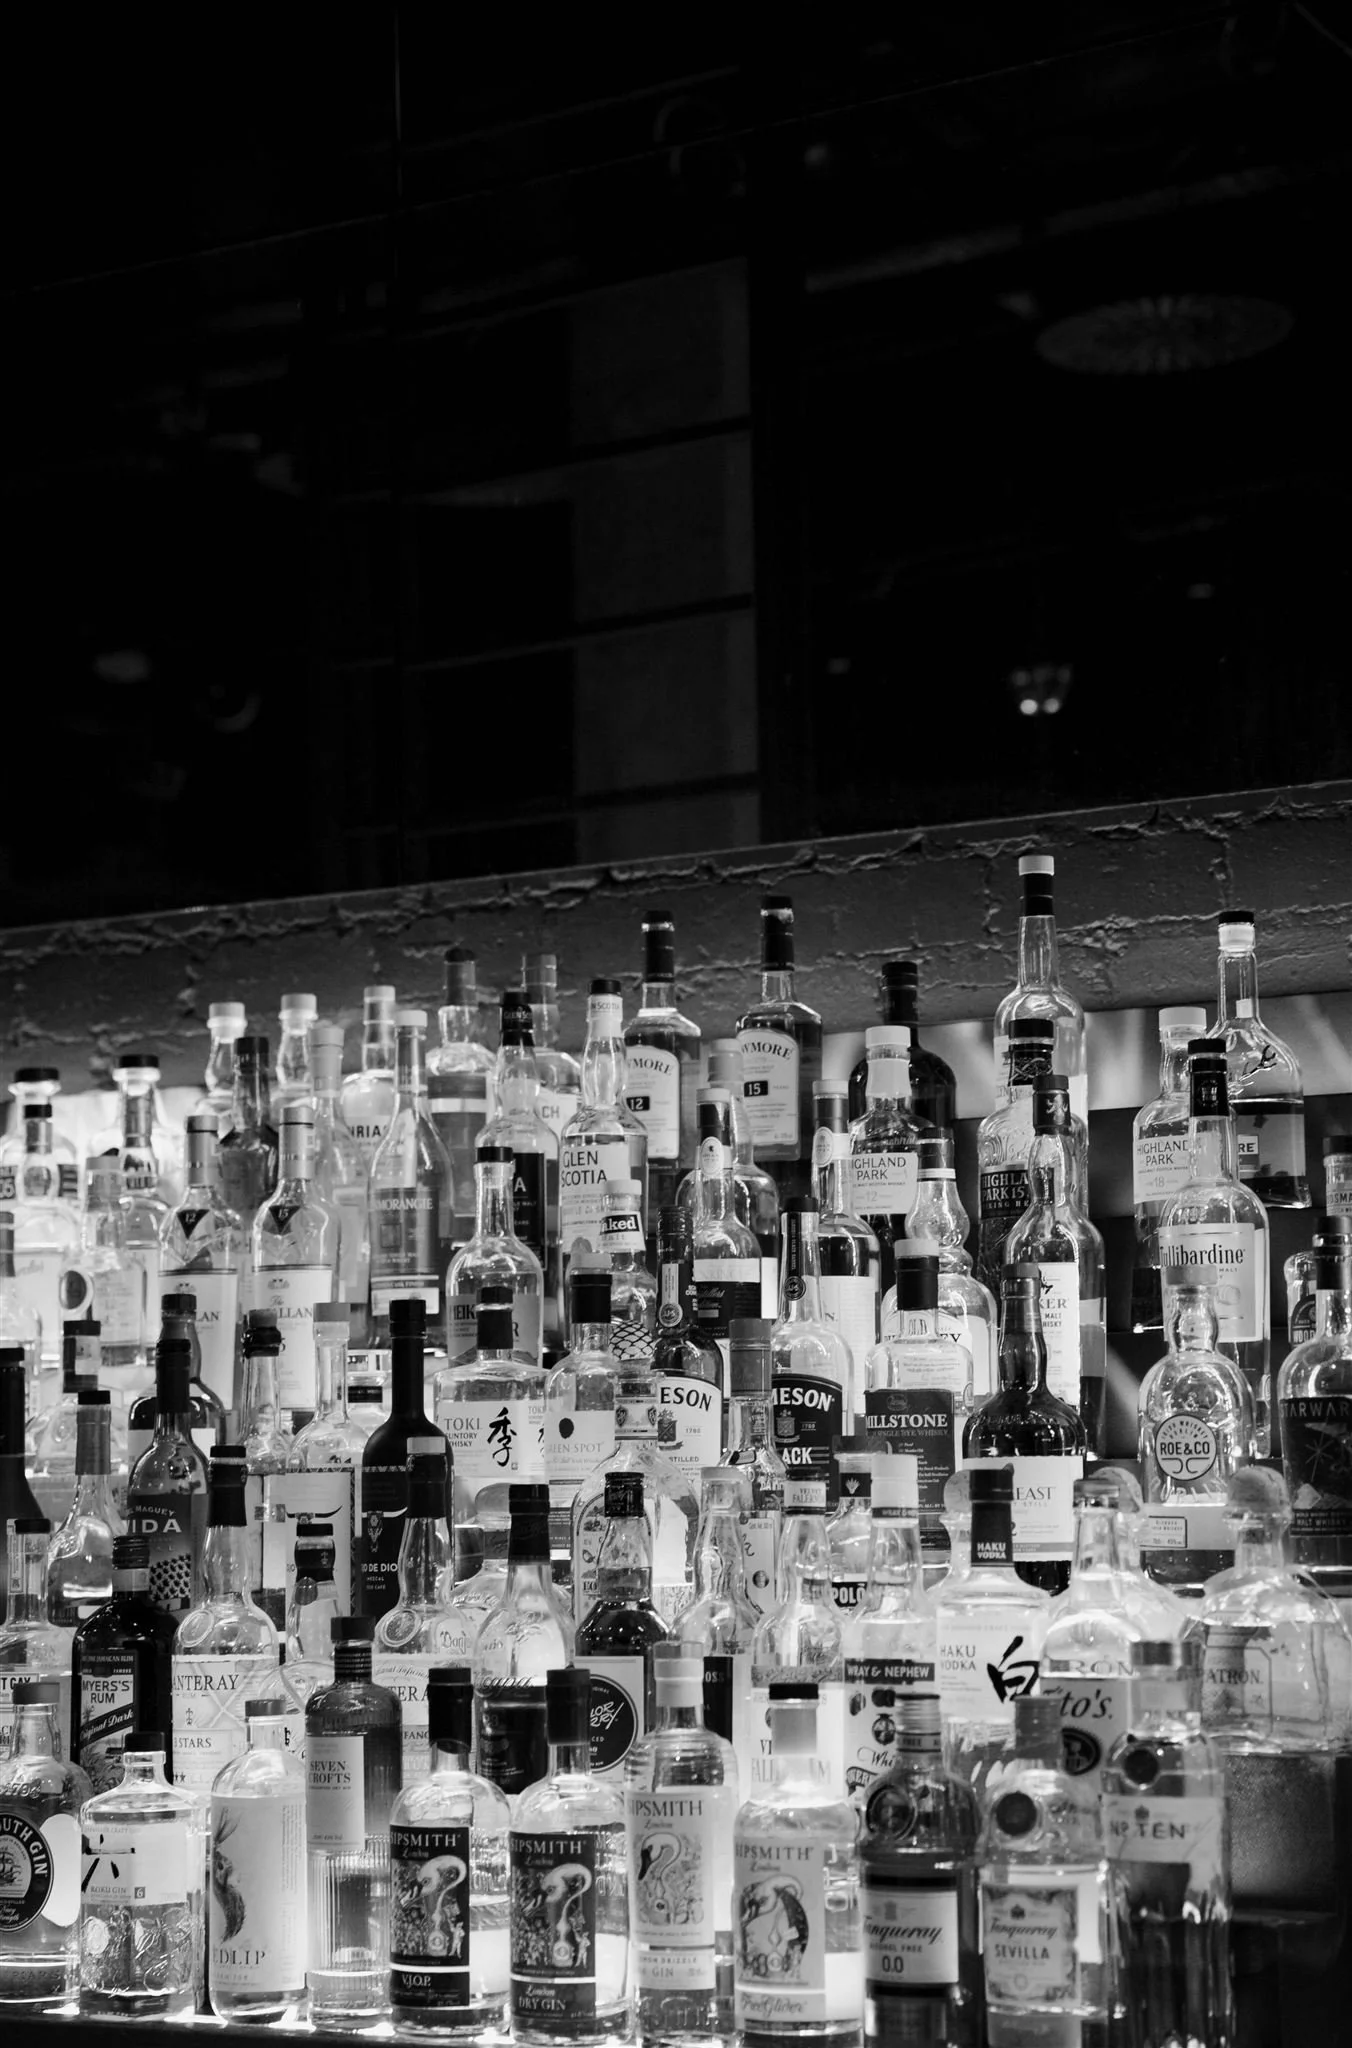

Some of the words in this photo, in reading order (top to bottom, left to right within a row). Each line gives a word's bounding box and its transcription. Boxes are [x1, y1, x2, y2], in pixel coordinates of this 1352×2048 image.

[628, 1056, 673, 1077] MORE
[748, 1082, 761, 1096] 15
[630, 1097, 644, 1111] 12
[563, 1150, 598, 1168] GLEN
[1145, 1152, 1174, 1167] PARK
[561, 1169, 608, 1187] SCOTIA
[856, 1169, 889, 1181] PARK
[1154, 1176, 1165, 1188] 18
[866, 1190, 878, 1202] 12
[982, 1186, 1009, 1201] PARK
[1011, 1187, 1026, 1199] 15
[185, 1212, 197, 1223] 12
[277, 1208, 290, 1218] 15
[1044, 1312, 1063, 1320] MALT
[660, 1387, 712, 1412] ESON
[443, 1417, 483, 1431] TOKI
[866, 1413, 949, 1429] MILLSTONE
[486, 1406, 518, 1468] 季
[900, 1429, 918, 1437] RYE
[919, 1428, 949, 1437] WHISKY
[574, 1442, 602, 1453] SPOT
[1160, 1441, 1210, 1455] ROE&CO
[781, 1446, 813, 1465] ACK
[1016, 1486, 1056, 1501] EAST
[135, 1504, 176, 1517] MAGUEY
[976, 1541, 1007, 1551] HAKU
[976, 1551, 1007, 1559] VODKA
[368, 1563, 379, 1572] DE
[380, 1562, 398, 1572] DIO
[940, 1645, 976, 1659] HAKU
[846, 1665, 870, 1679] WRAY
[871, 1666, 881, 1678] &
[884, 1665, 930, 1678] NEPHEW
[82, 1680, 130, 1692] MYERS'S
[90, 1692, 115, 1704] RUM
[108, 1708, 134, 1727] Dark
[178, 1736, 212, 1749] STARS
[309, 1760, 347, 1772] SEVEN
[308, 1772, 351, 1784] CROFTS
[1138, 1821, 1187, 1841] TEN
[0, 1816, 33, 1843] UTH
[29, 1840, 49, 1877] GIN
[390, 1832, 459, 1848] SIPSMITH
[510, 1839, 583, 1855] SIPSMITH
[90, 1885, 112, 1894] ROKU
[112, 1886, 127, 1894] GIN
[901, 1943, 923, 1953] FREE
[994, 1943, 1050, 1960] SEVILLA
[661, 1956, 698, 1964] DRIZZLE
[652, 1967, 674, 1978] GIN
[518, 1996, 538, 2010] DRY
[540, 1998, 567, 2012] GIN
